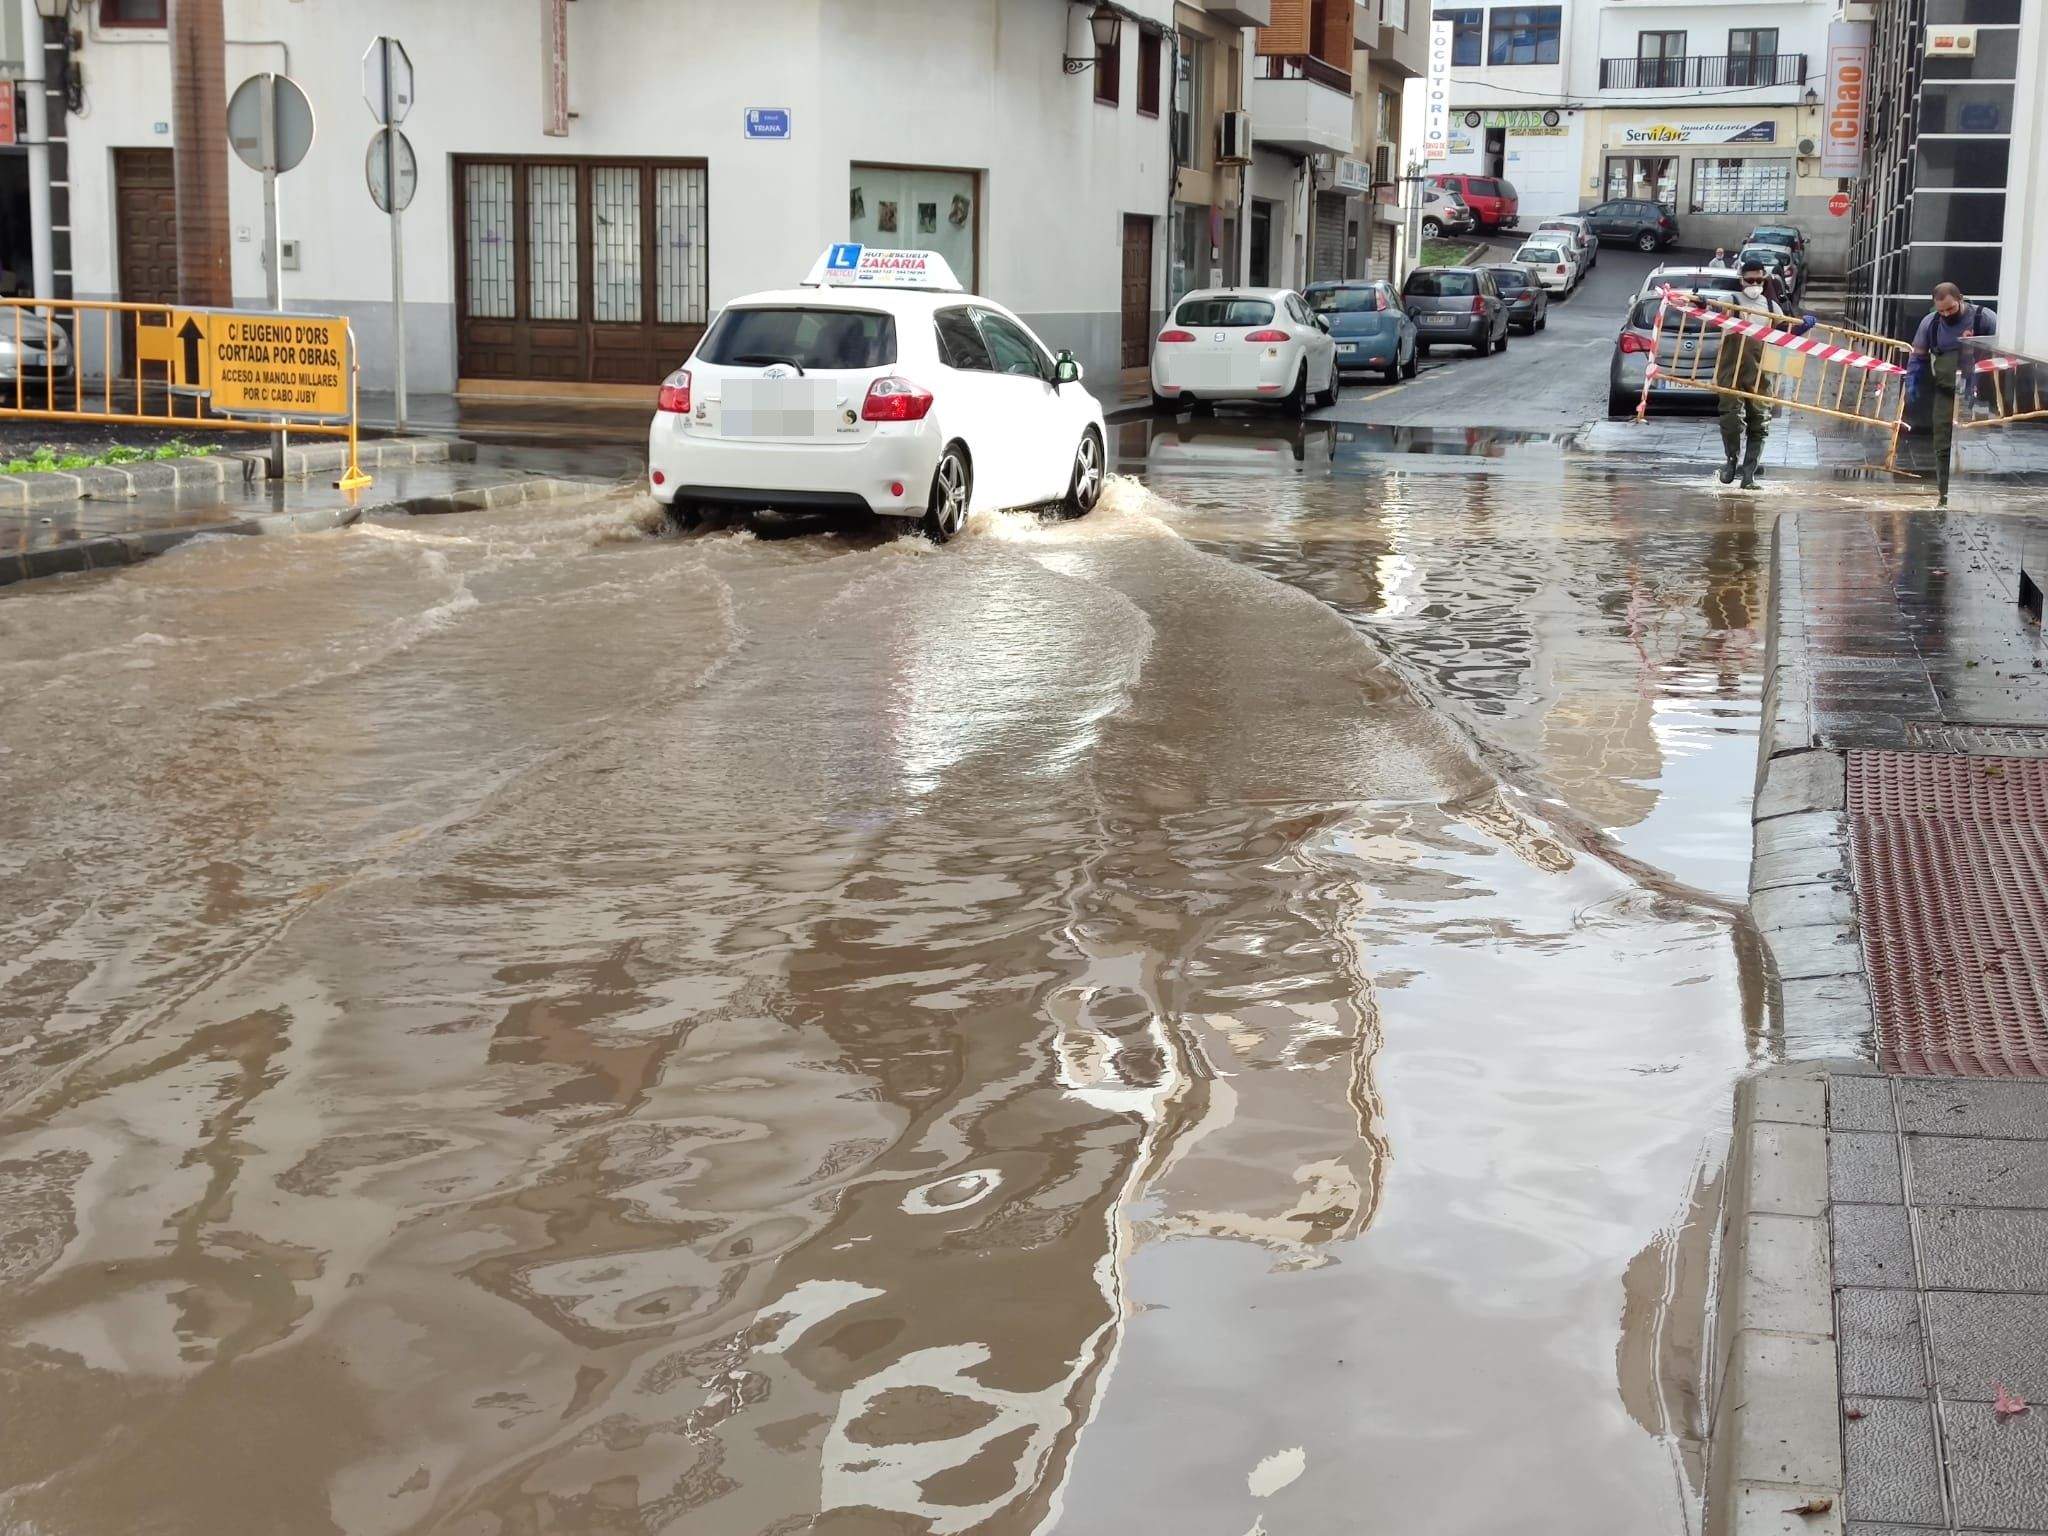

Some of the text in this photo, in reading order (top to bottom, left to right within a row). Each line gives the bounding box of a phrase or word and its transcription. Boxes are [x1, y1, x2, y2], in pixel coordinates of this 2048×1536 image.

[1429, 24, 1447, 140] LOCUTORIO
[1626, 126, 1692, 142] Servilanz
[1681, 122, 1748, 131] Inmobiliaria
[1829, 200, 1848, 209] STOP
[835, 247, 849, 266] L
[860, 258, 926, 269] ZAKARIA
[242, 324, 292, 344] EUGENIO
[296, 327, 329, 345] D'ORS
[218, 344, 340, 370] CORTADA POR OBRAS,
[221, 369, 338, 387] ACCESO A MANOLO MILLARES
[243, 387, 260, 400] POR
[271, 389, 293, 402] CABO
[296, 390, 317, 403] JUBY
